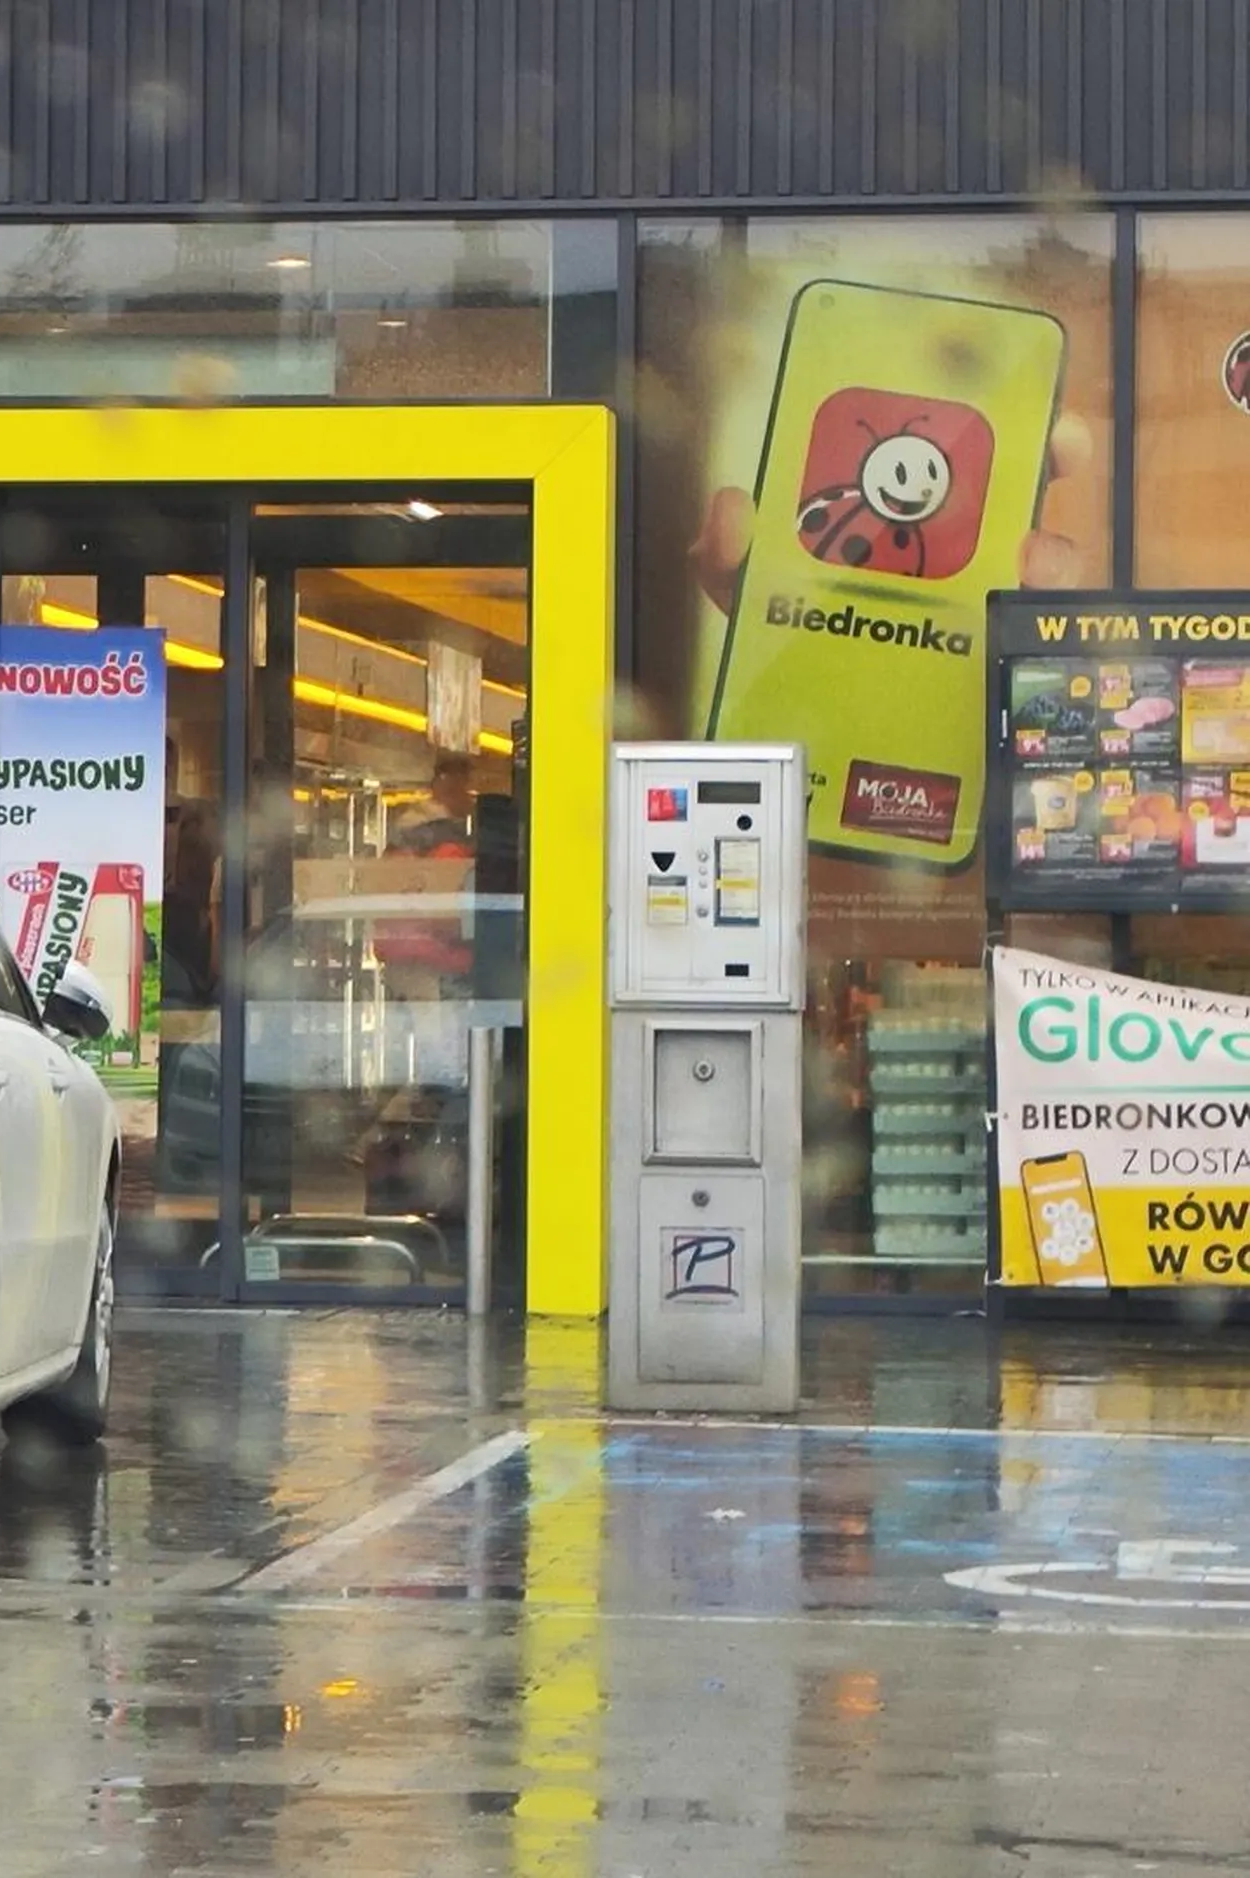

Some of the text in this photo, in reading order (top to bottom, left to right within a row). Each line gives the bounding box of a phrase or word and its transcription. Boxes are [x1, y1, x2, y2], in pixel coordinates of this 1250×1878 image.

[765, 595, 973, 656] Biedronka
[1037, 615, 1067, 640] W
[1076, 615, 1140, 640] TYM
[857, 777, 928, 808] MOJA
[1019, 968, 1097, 989] TYLKO
[1105, 981, 1129, 996] W
[1122, 1148, 1139, 1174] Z
[1149, 1191, 1250, 1231] RÓW
[1147, 1244, 1190, 1274] W
